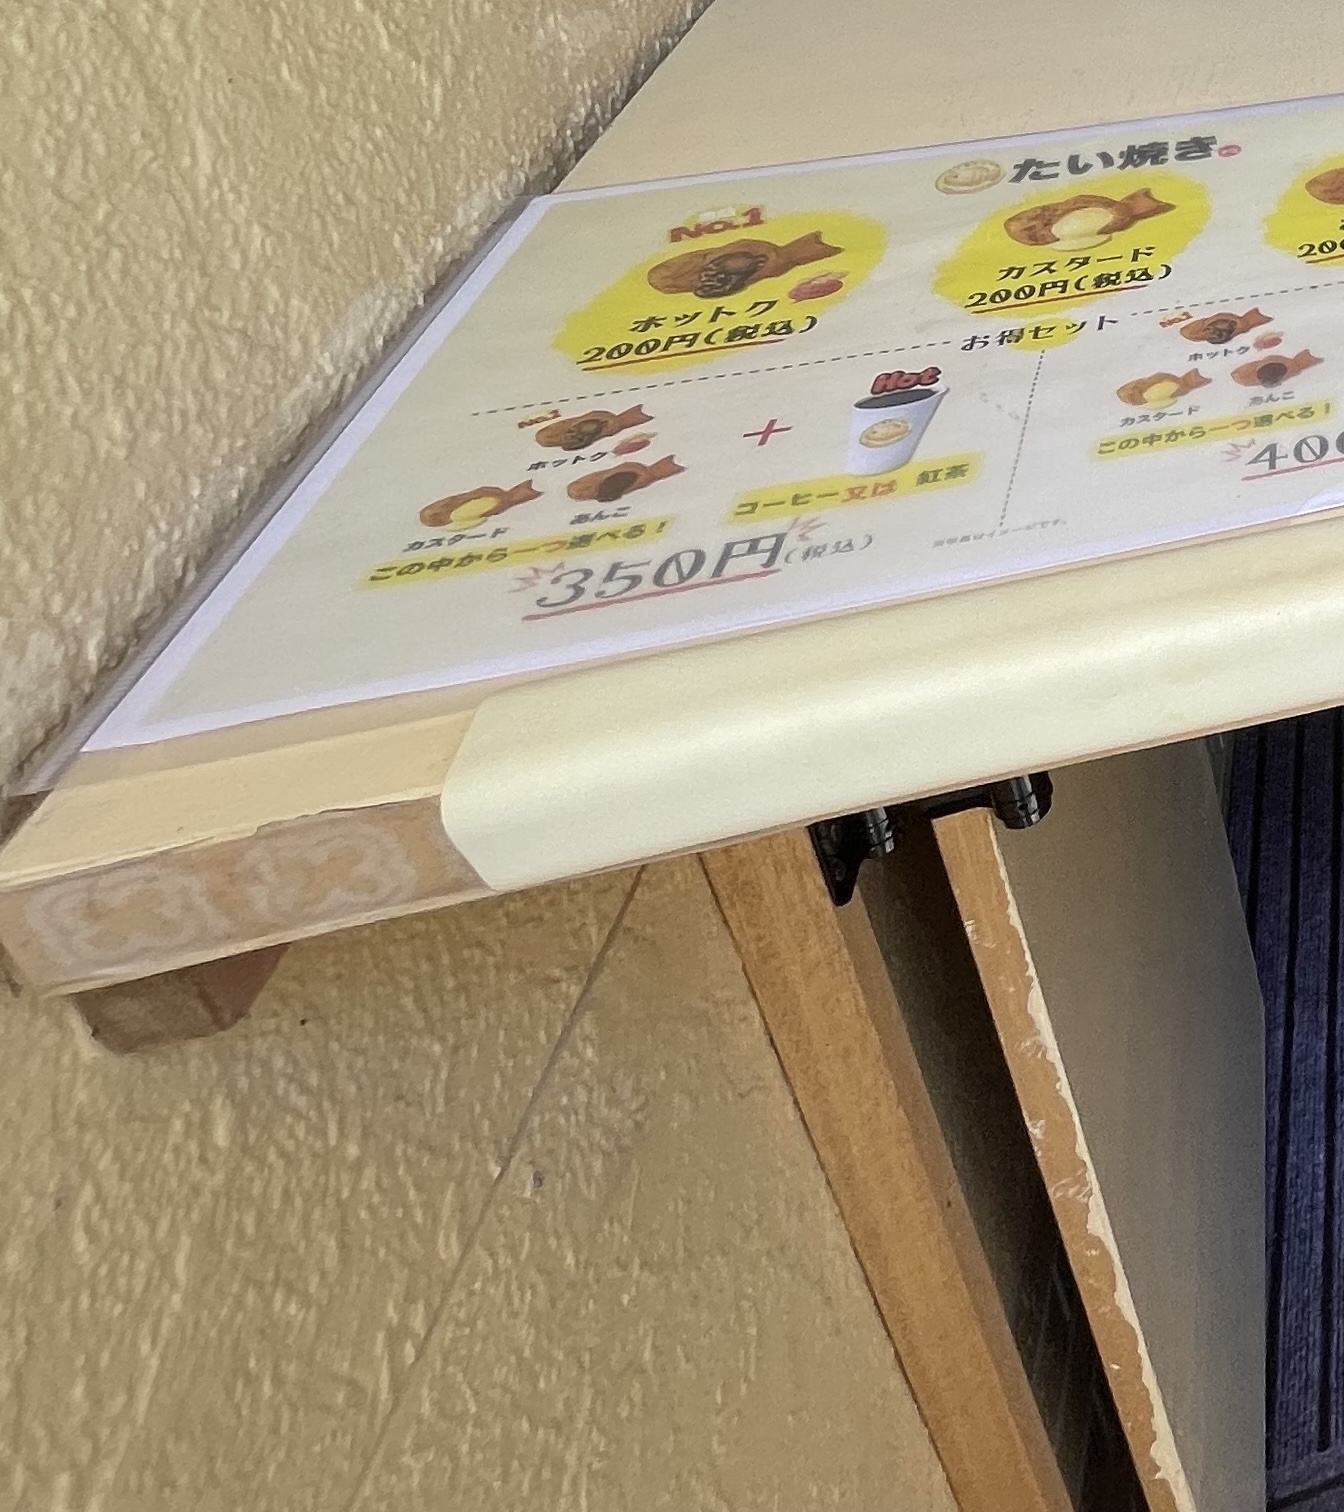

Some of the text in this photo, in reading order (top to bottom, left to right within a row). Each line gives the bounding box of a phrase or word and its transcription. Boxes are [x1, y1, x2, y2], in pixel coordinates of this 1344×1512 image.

[1008, 135, 1220, 184] たい焼き
[996, 246, 1157, 282] カスタード
[964, 263, 1174, 310] 200円(税込)
[629, 299, 779, 334] ホットク
[960, 314, 1119, 352] お得セット
[575, 314, 819, 365] 200円(税込)
[1188, 345, 1251, 362] ホットク
[1119, 405, 1201, 428] カスタード
[917, 463, 970, 486] 紅茶
